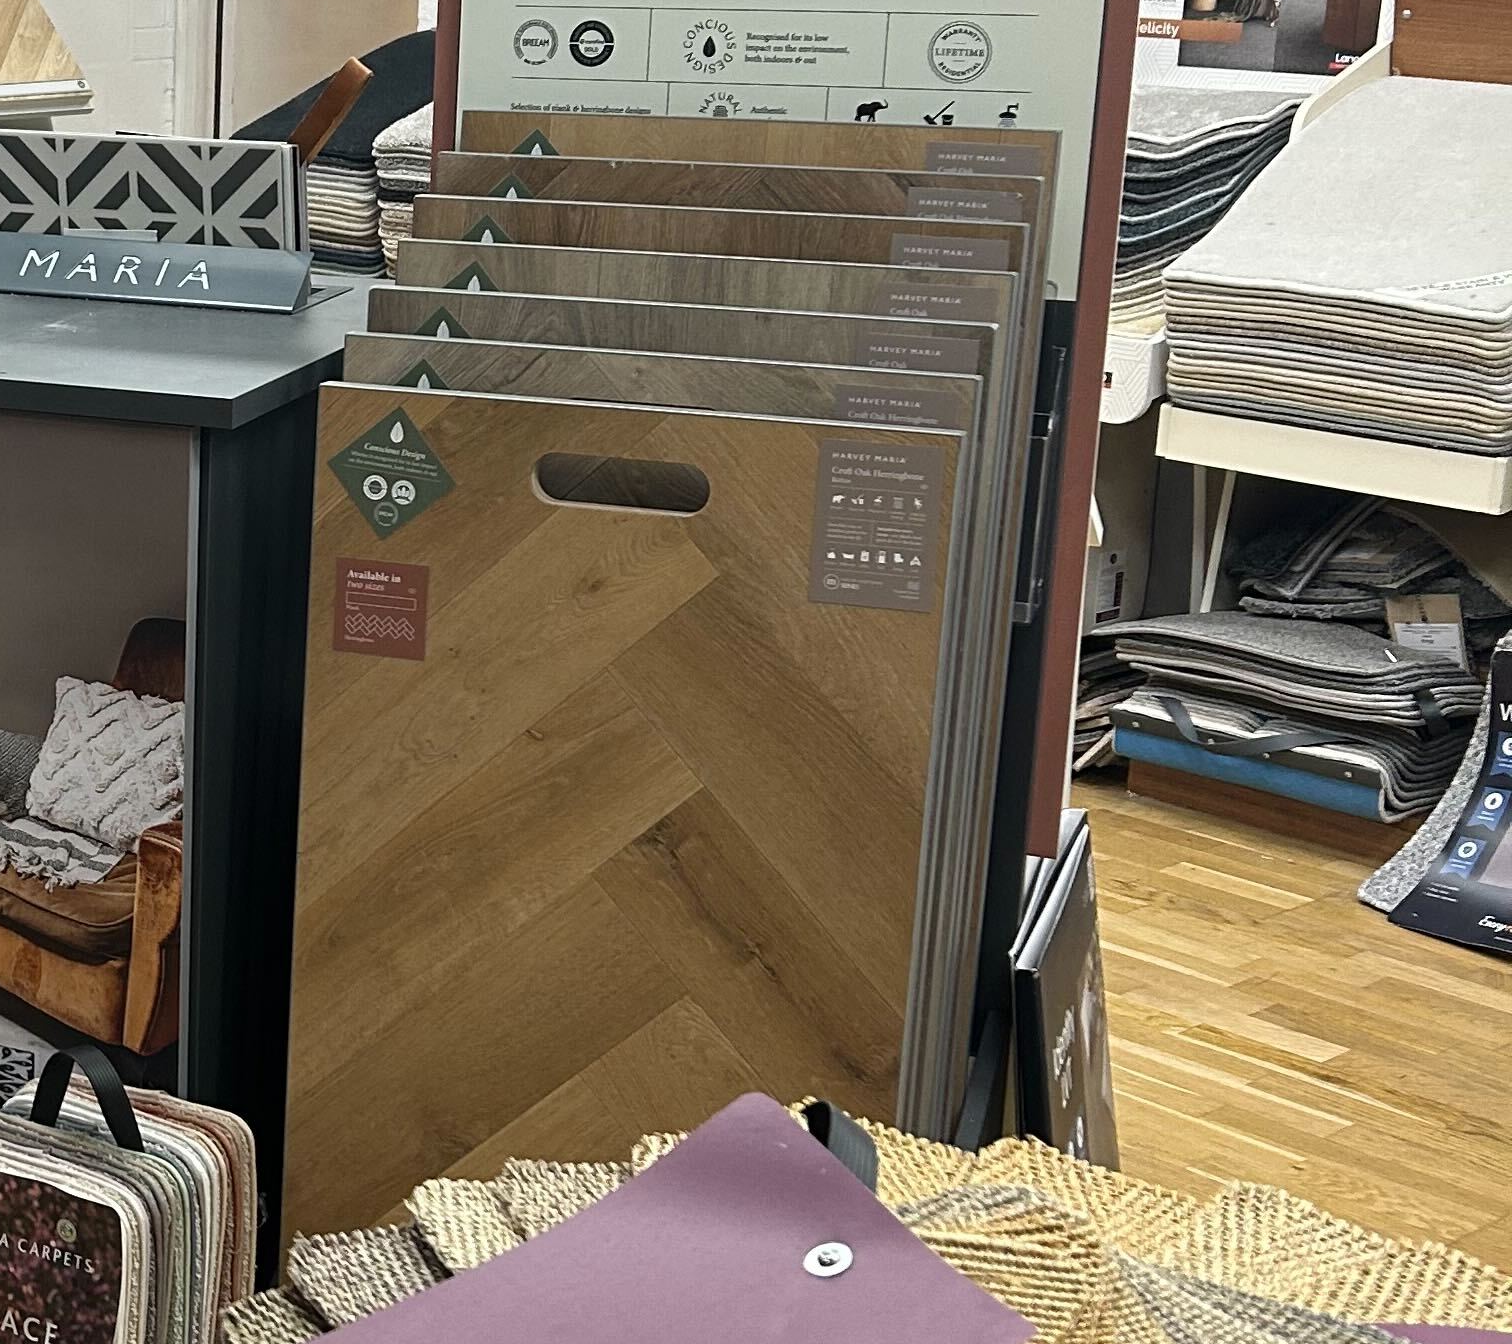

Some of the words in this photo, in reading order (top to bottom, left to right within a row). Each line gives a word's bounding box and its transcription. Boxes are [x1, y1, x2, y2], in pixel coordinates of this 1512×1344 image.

[791, 33, 802, 41] for
[941, 27, 982, 43] WARRANTY
[935, 47, 985, 57] LIFETIME
[684, 52, 734, 75] DESIGN
[18, 250, 211, 292] MARIA
[831, 452, 871, 462] HARVEY
[874, 455, 907, 464] MARIA
[347, 568, 390, 582] Available
[391, 573, 401, 583] in
[17, 1238, 95, 1274] CARPETS
